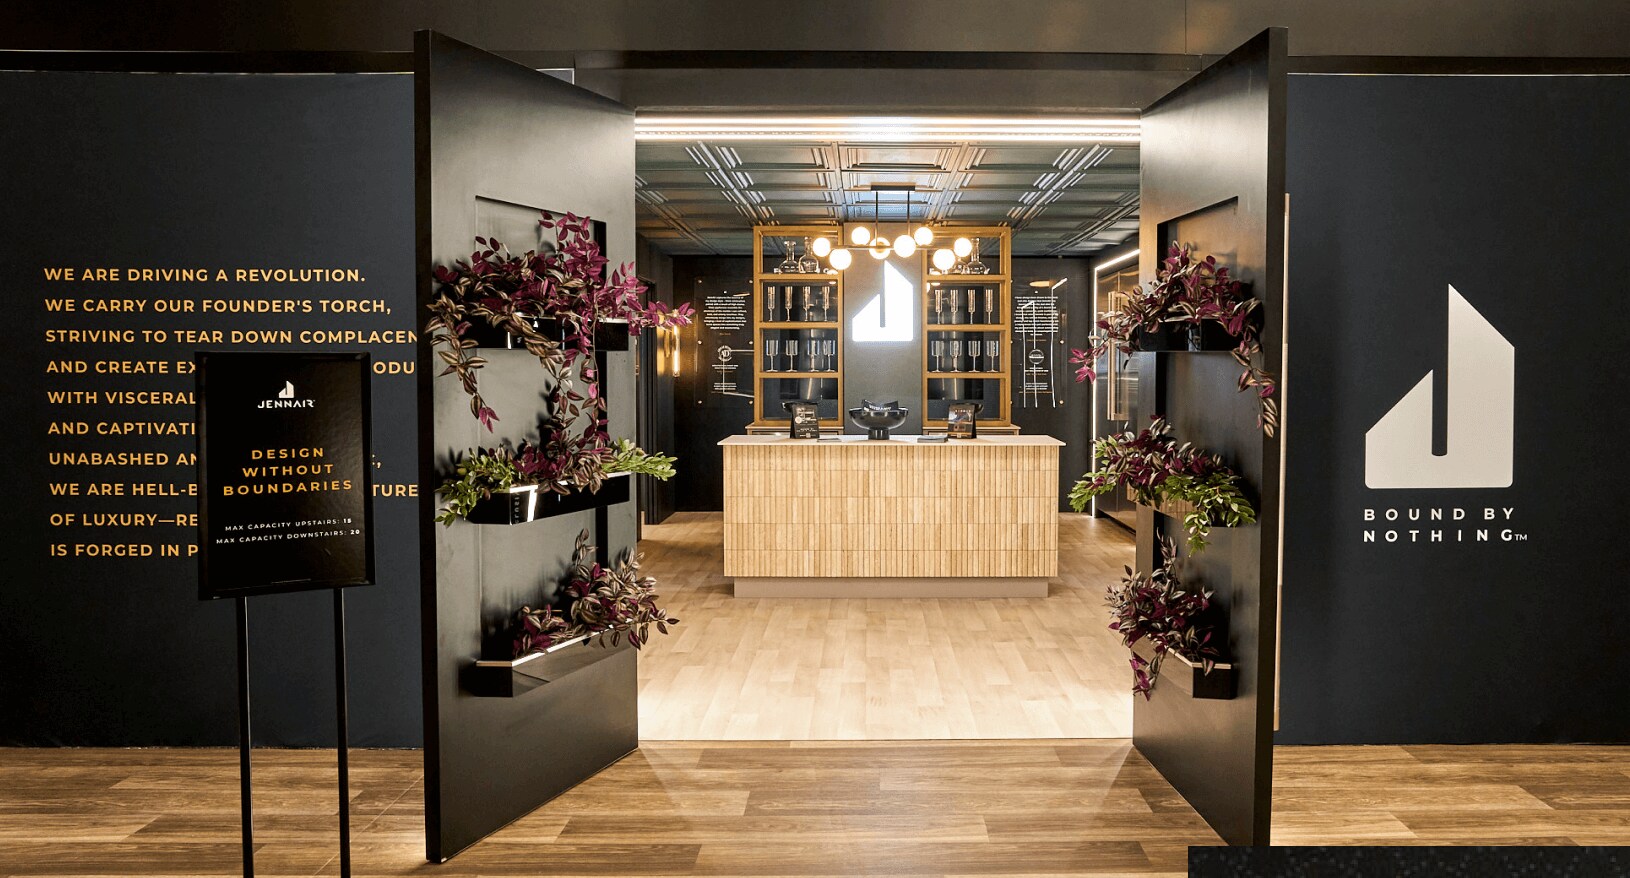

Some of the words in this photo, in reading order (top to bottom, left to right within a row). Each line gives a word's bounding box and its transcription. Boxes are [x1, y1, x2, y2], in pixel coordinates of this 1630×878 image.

[44, 268, 75, 281] WE
[82, 268, 120, 281] ARE
[128, 269, 208, 282] DRIVING
[216, 269, 229, 282] A
[236, 269, 366, 283] REVOLUTION.
[45, 299, 76, 312] WE
[83, 299, 147, 312] CARRY
[154, 299, 195, 313] OUR
[203, 299, 313, 313] FOUNDER'S
[319, 300, 392, 315] TORCH,
[46, 329, 135, 343] STRIVING
[142, 330, 168, 343] TO
[174, 330, 223, 343] TEAR
[232, 330, 292, 343] DOWN
[47, 360, 88, 373] AND
[96, 360, 169, 374] CREATE
[48, 391, 98, 404] WITH
[105, 391, 196, 404] VISCERAL
[257, 399, 314, 409] JENNAIR
[48, 422, 89, 435] AND
[50, 452, 169, 466] UNABASHED
[251, 447, 325, 460] DESIGN
[242, 463, 334, 478] WITHOUT
[50, 483, 80, 496] WE
[87, 483, 125, 496] ARE
[223, 480, 353, 496] BOUNDARIES
[50, 513, 75, 526] OF
[1363, 507, 1466, 521] BOUND
[1483, 507, 1515, 520] BY
[247, 522, 292, 530] CAPACITY
[295, 519, 340, 527] UPSTAIRS:
[239, 534, 283, 543] CAPACITY
[286, 530, 347, 539] DOWNSTAIRS:
[51, 544, 68, 557] IS
[76, 544, 153, 557] FORGED
[161, 544, 180, 557] IN
